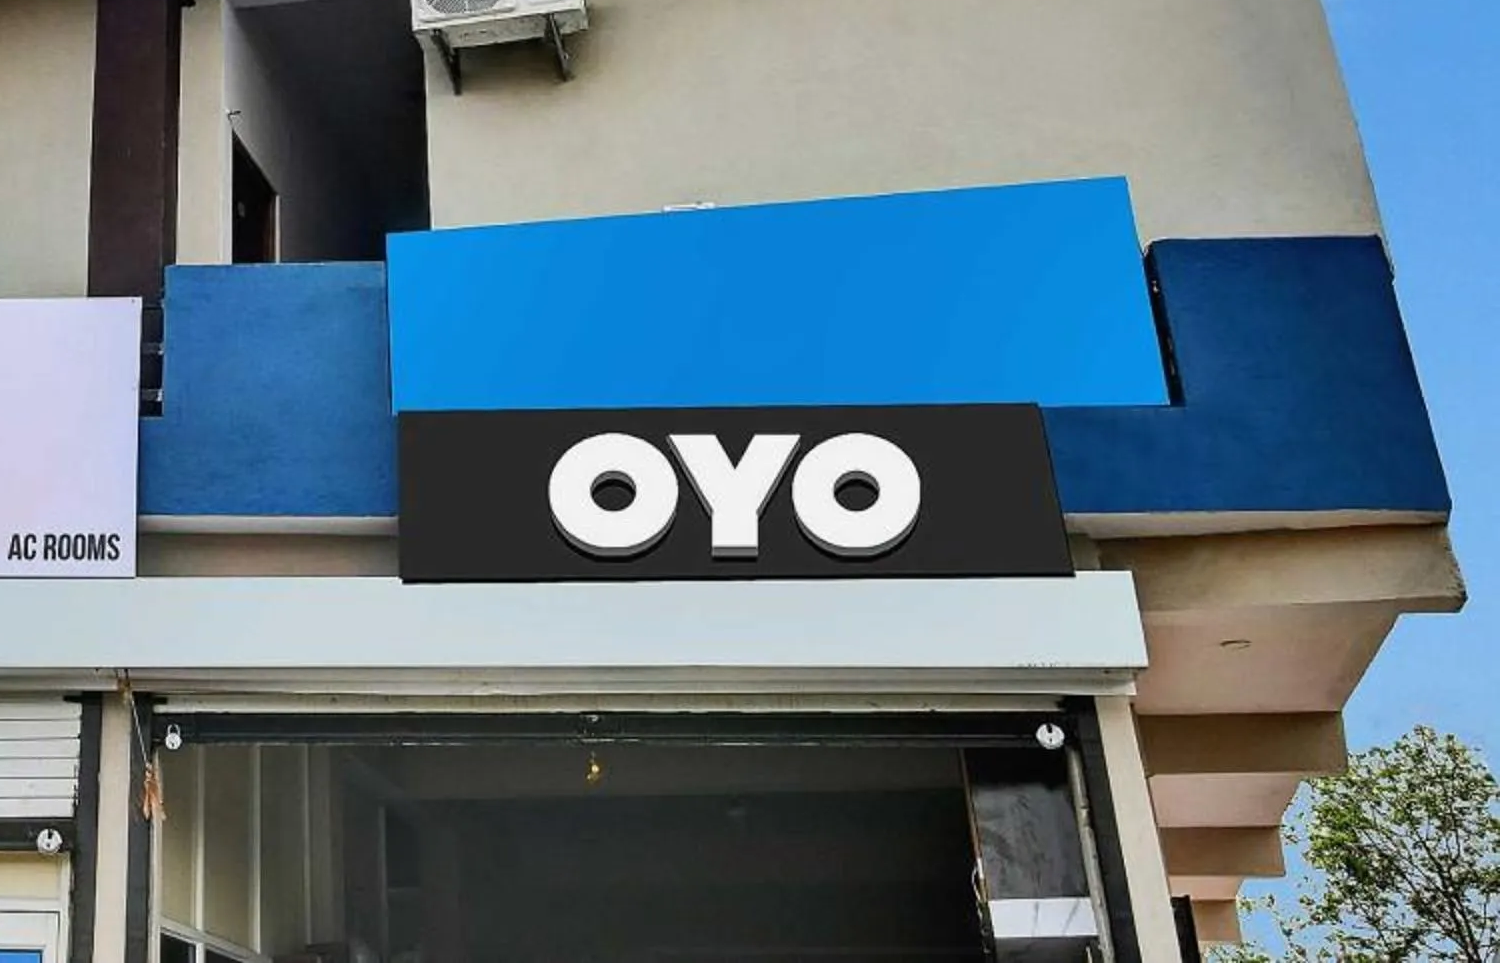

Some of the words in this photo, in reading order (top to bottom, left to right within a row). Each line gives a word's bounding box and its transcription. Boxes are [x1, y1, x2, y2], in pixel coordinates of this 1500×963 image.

[548, 433, 921, 556] OYO
[7, 533, 37, 561] AC
[43, 533, 121, 561] ROOMS
